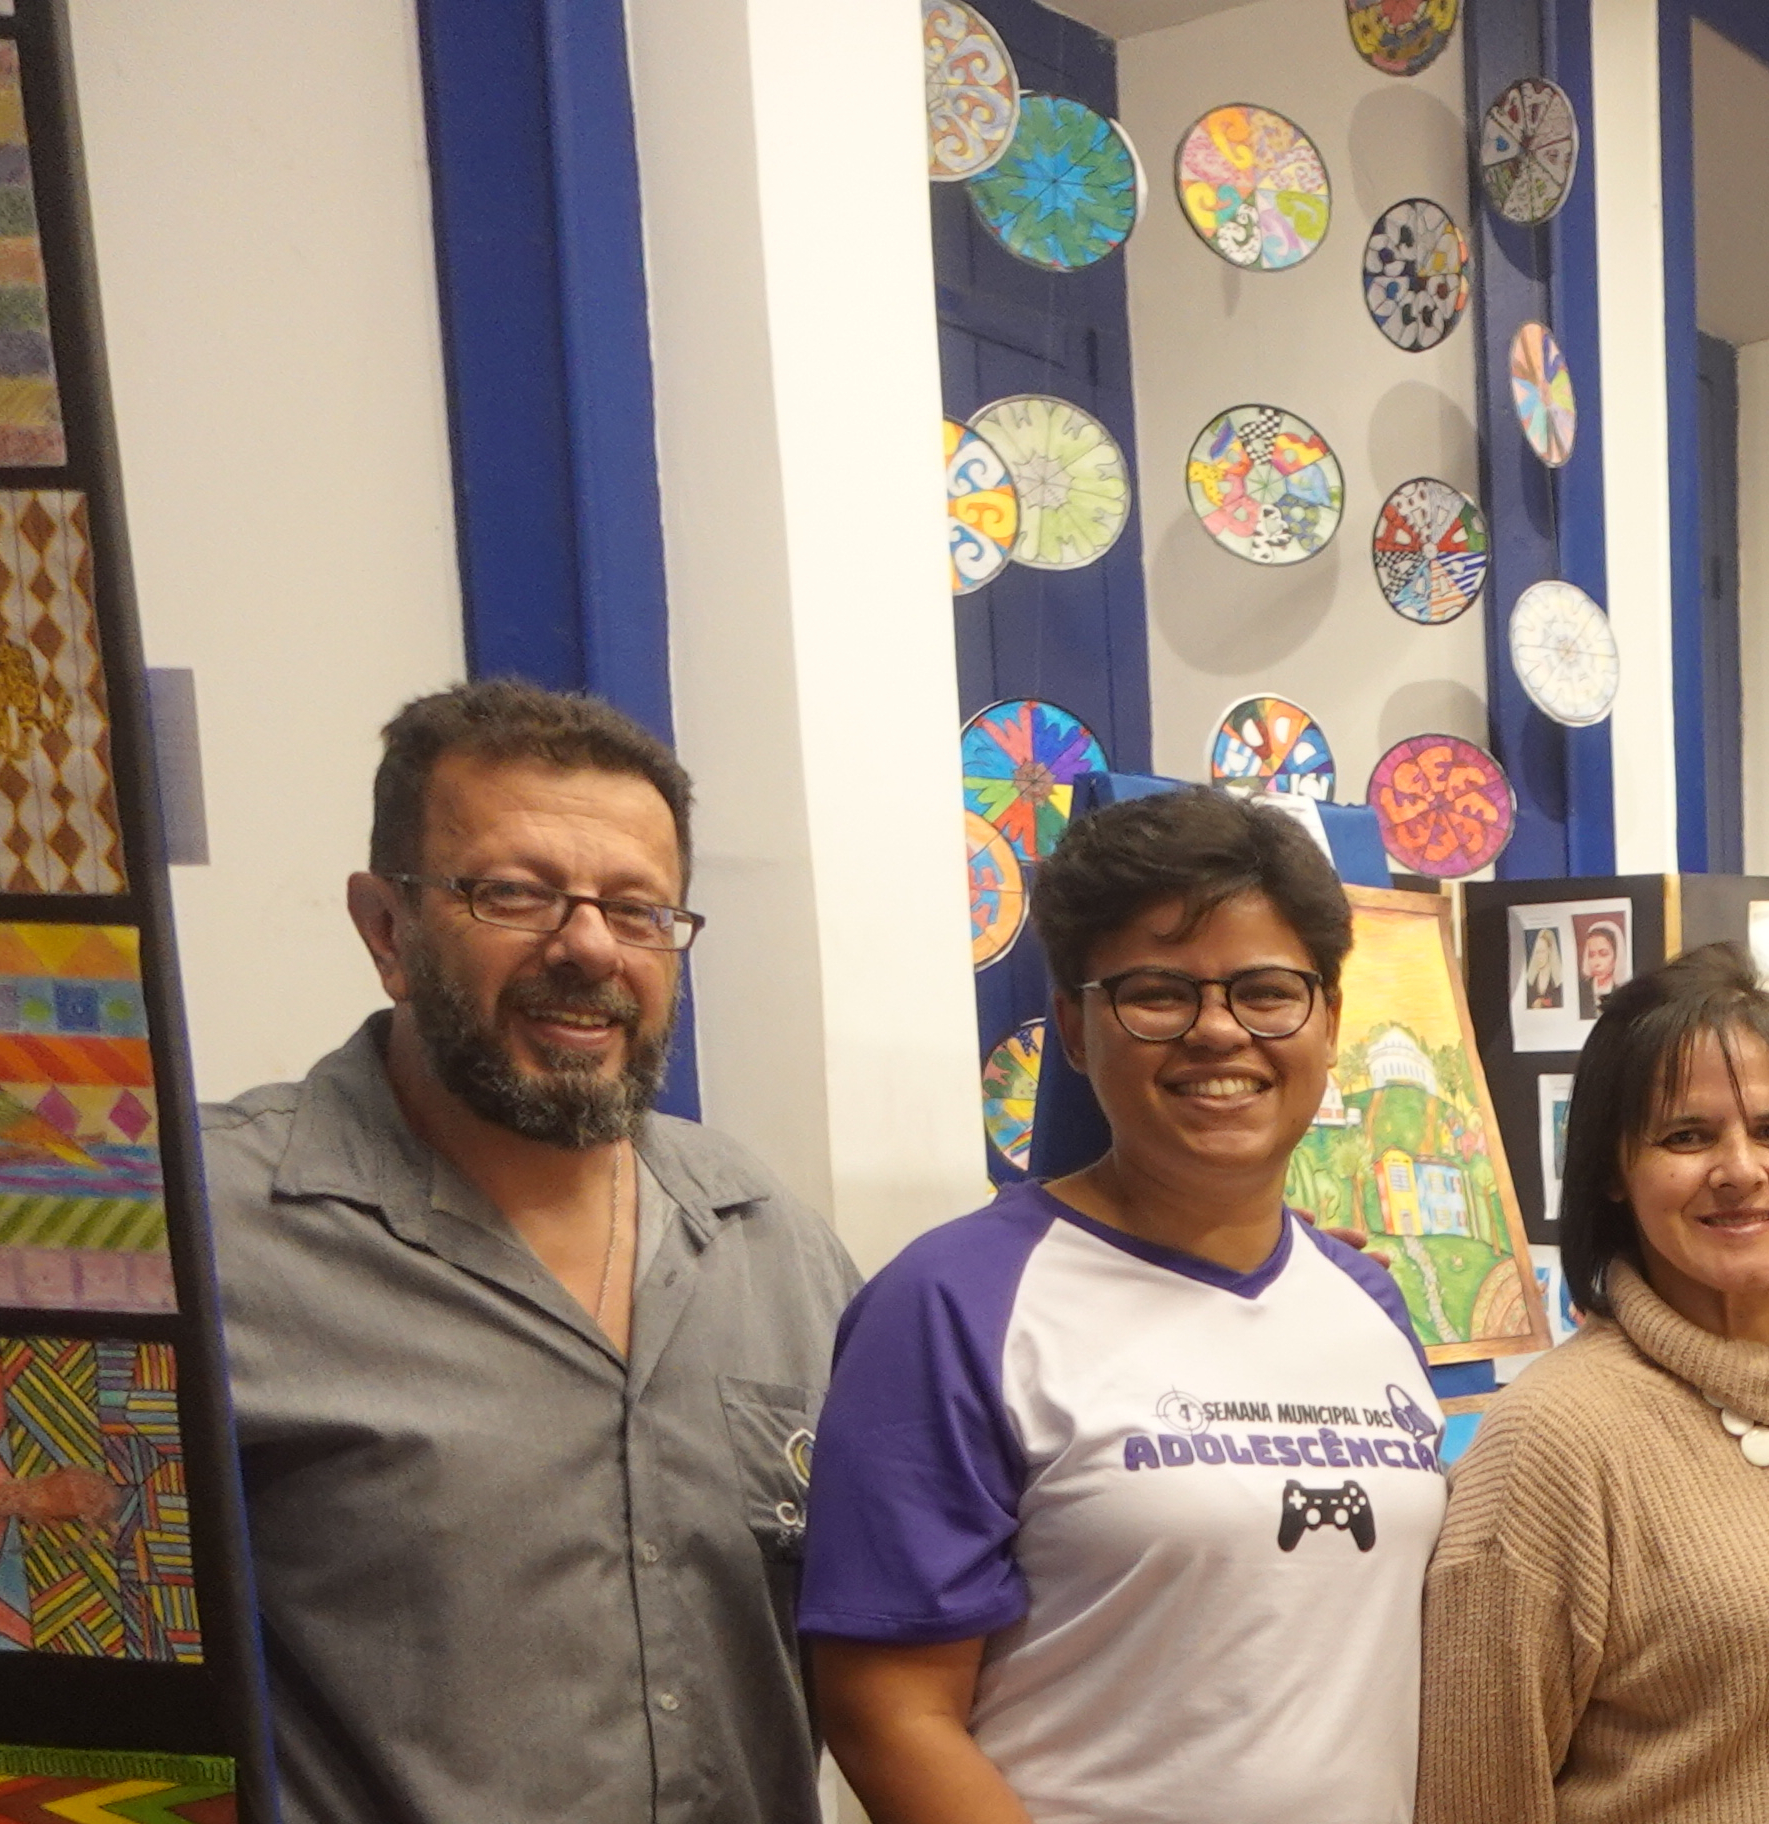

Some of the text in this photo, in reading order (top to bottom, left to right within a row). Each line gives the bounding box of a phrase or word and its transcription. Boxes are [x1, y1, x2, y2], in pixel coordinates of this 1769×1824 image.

[1204, 1401, 1273, 1423] SEMANA
[1277, 1403, 1360, 1426] MUNICIPAL
[1364, 1408, 1393, 1428] DAS
[1124, 1427, 1443, 1474] ADOLESCÊNCIA
